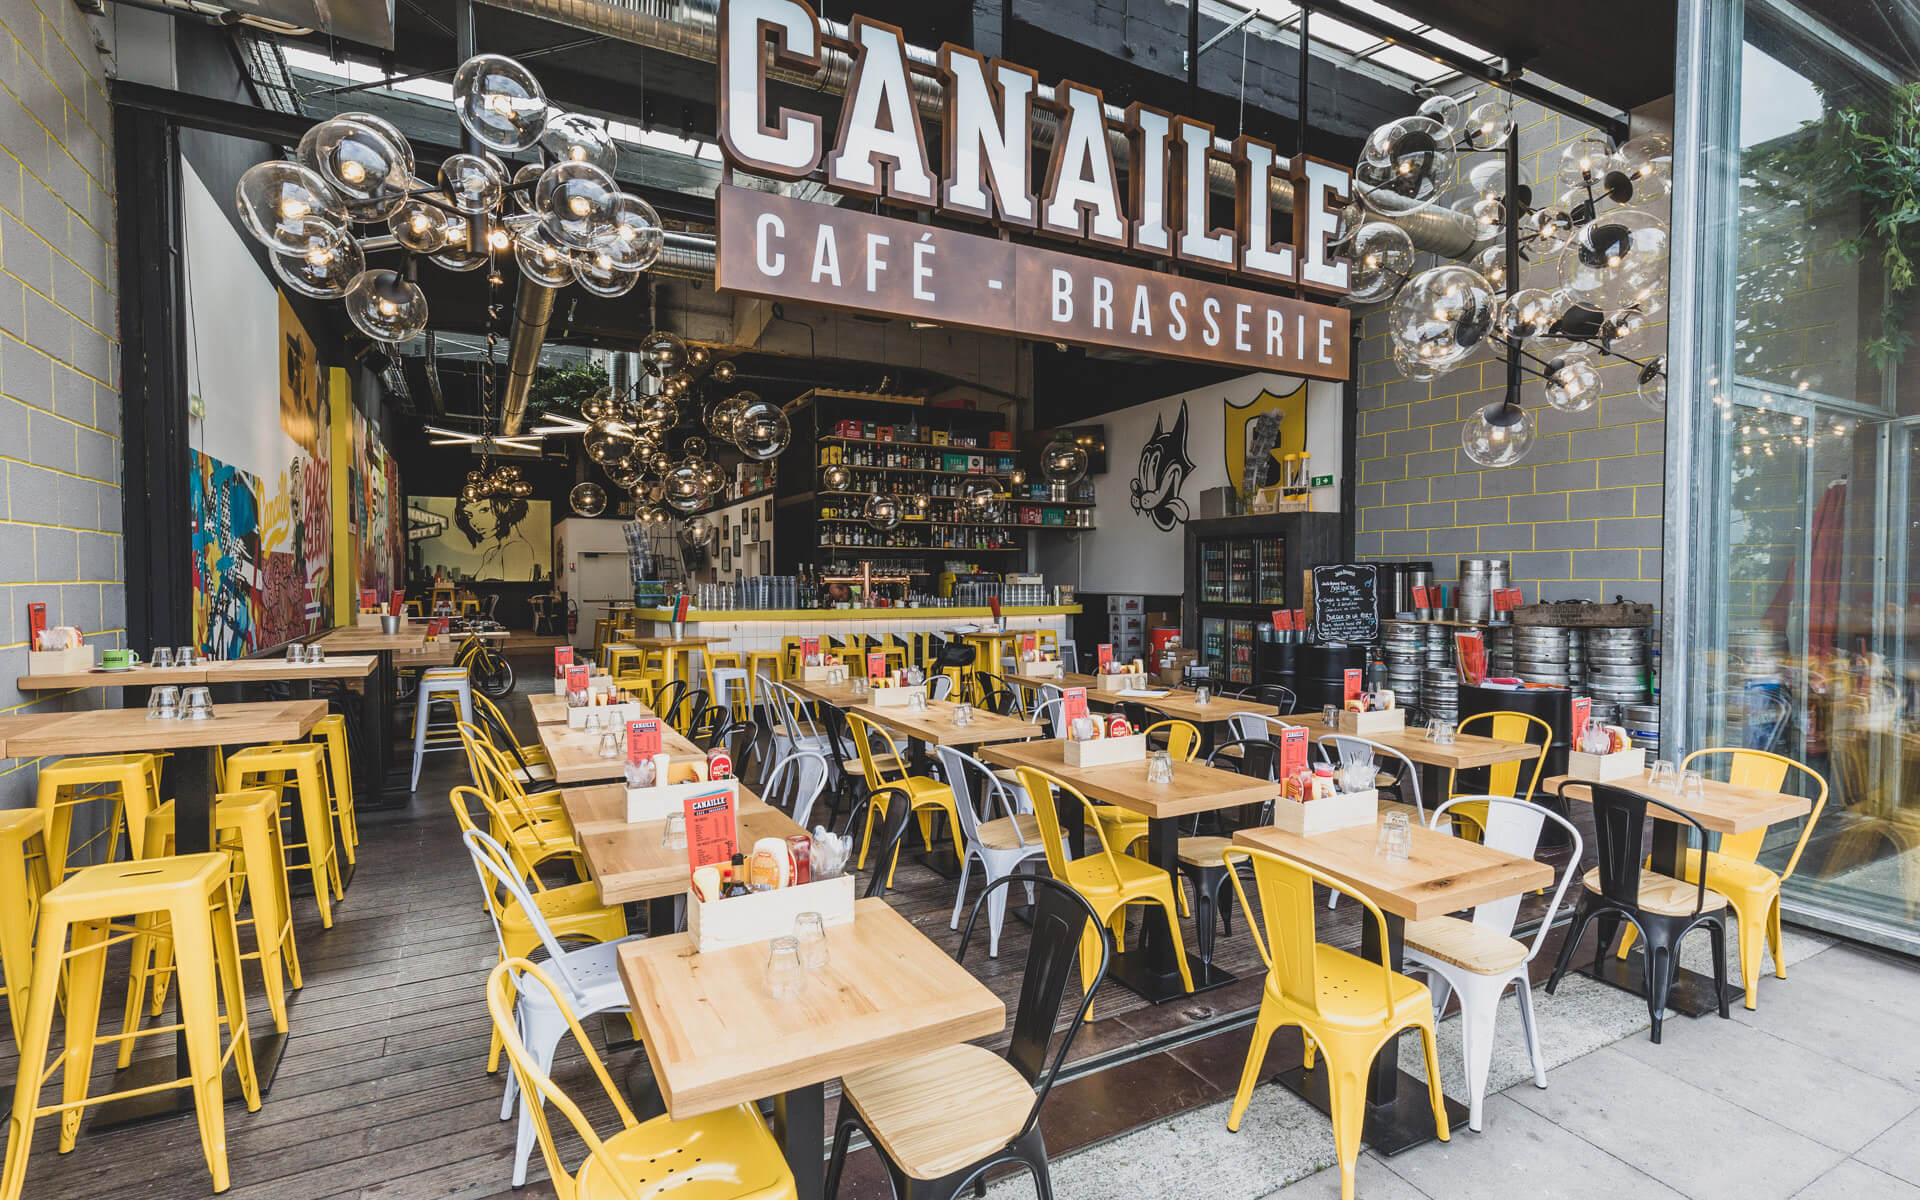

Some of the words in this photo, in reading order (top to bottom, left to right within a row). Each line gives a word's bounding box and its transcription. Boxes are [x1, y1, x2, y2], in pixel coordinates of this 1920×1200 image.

[720, 0, 1352, 294] CANAILLE
[755, 212, 938, 302] CAFÉ
[1050, 268, 1334, 366] BRASSERIE
[692, 796, 728, 811] CANAILLE
